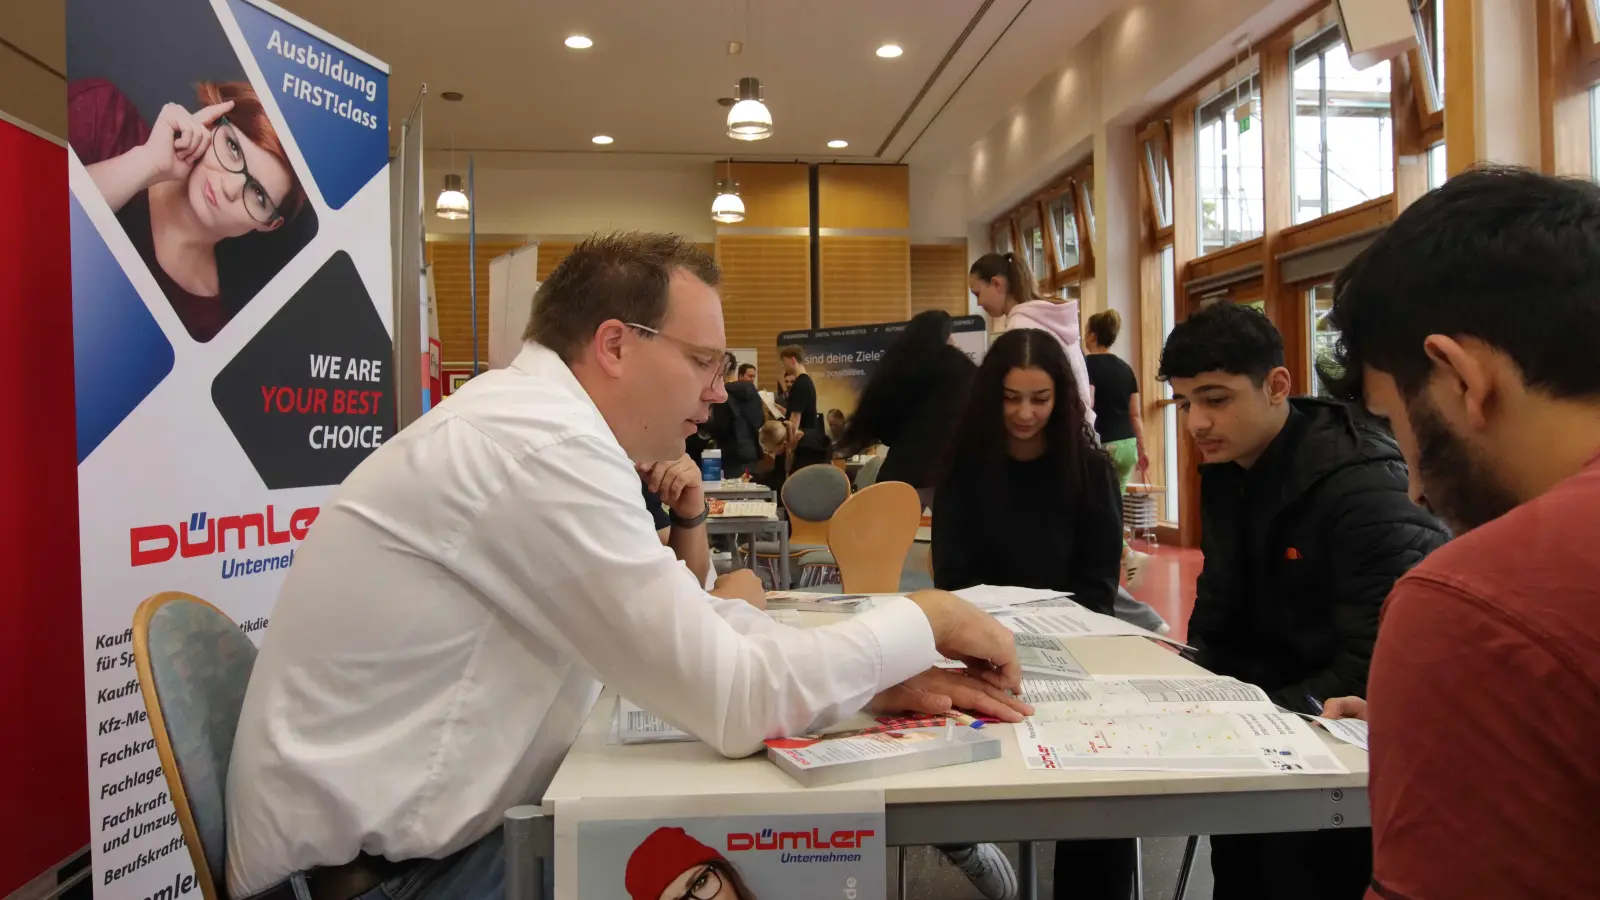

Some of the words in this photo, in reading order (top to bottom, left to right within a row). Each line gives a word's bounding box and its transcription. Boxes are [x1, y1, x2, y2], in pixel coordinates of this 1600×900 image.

[267, 29, 377, 102] Ausbildung
[282, 72, 377, 130] FIRST!class
[310, 354, 341, 379] WE
[345, 357, 382, 382] ARE
[804, 353, 824, 365] sind
[826, 352, 854, 364] deine
[261, 385, 328, 414] YOUR
[333, 389, 383, 415] BEST
[309, 425, 383, 449] CHOICE
[96, 656, 117, 672] für
[102, 792, 167, 831] Fachkraft
[103, 828, 130, 853] und
[133, 811, 178, 839] Umzug
[781, 852, 861, 864] Unternehmen
